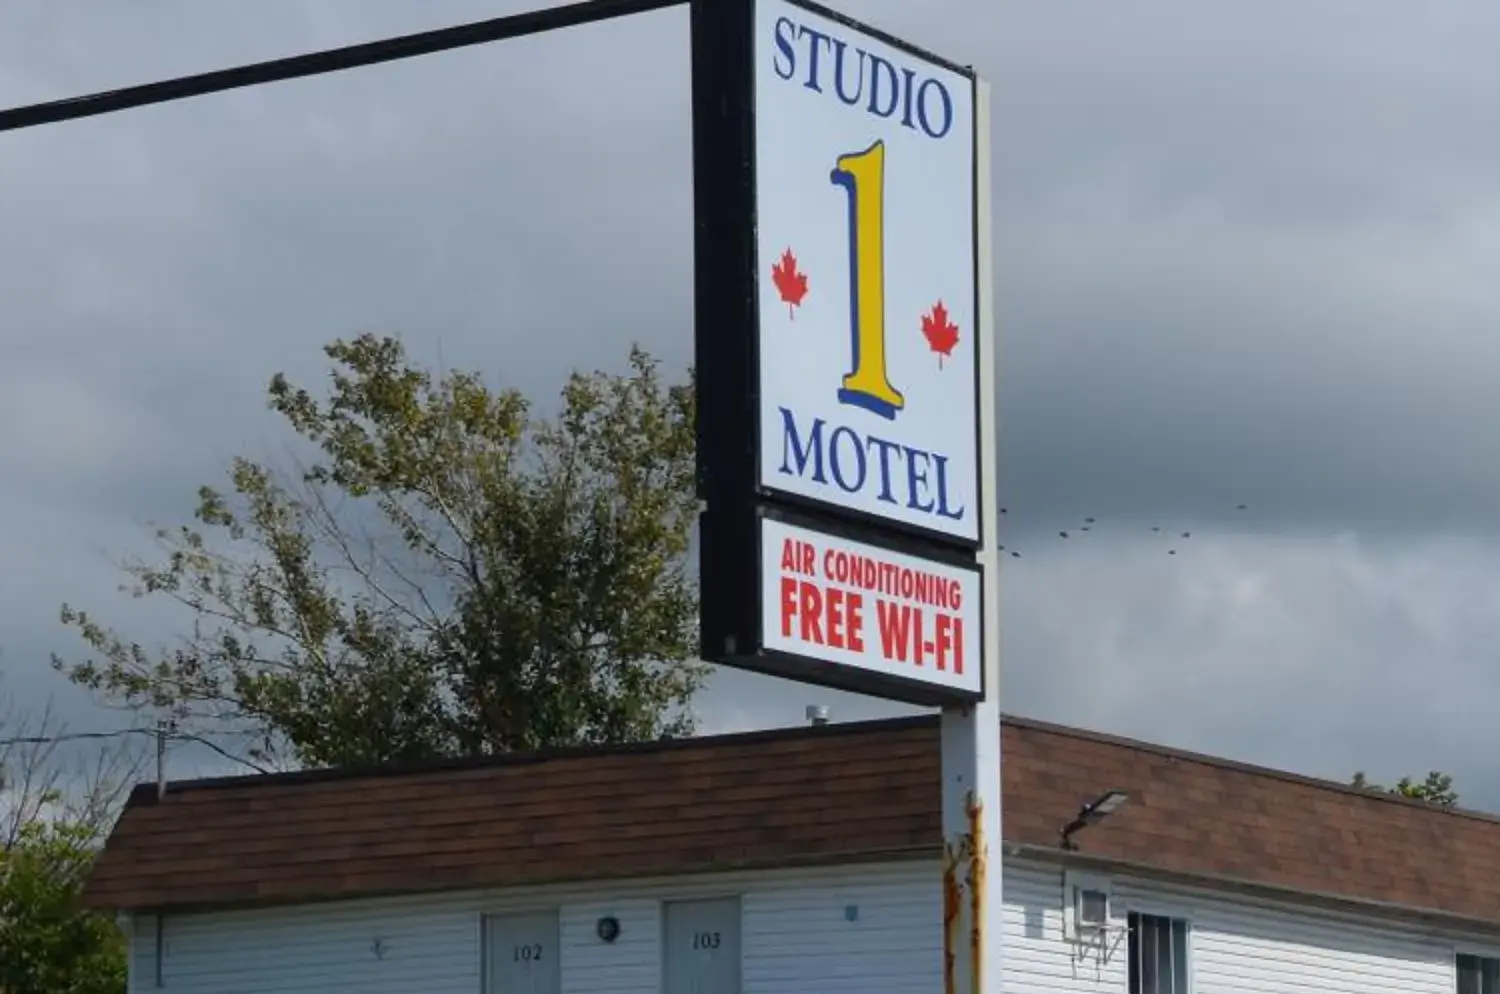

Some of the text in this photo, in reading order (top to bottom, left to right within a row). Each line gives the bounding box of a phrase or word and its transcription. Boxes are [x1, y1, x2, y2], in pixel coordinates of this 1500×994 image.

[773, 17, 953, 138] STUDIO
[830, 139, 904, 420] 1
[778, 406, 964, 520] MOTEL
[781, 538, 961, 610] AIR CONDITIONING
[780, 576, 963, 675] FREE WI-FI
[513, 943, 542, 962] 102
[692, 932, 721, 950] 103
